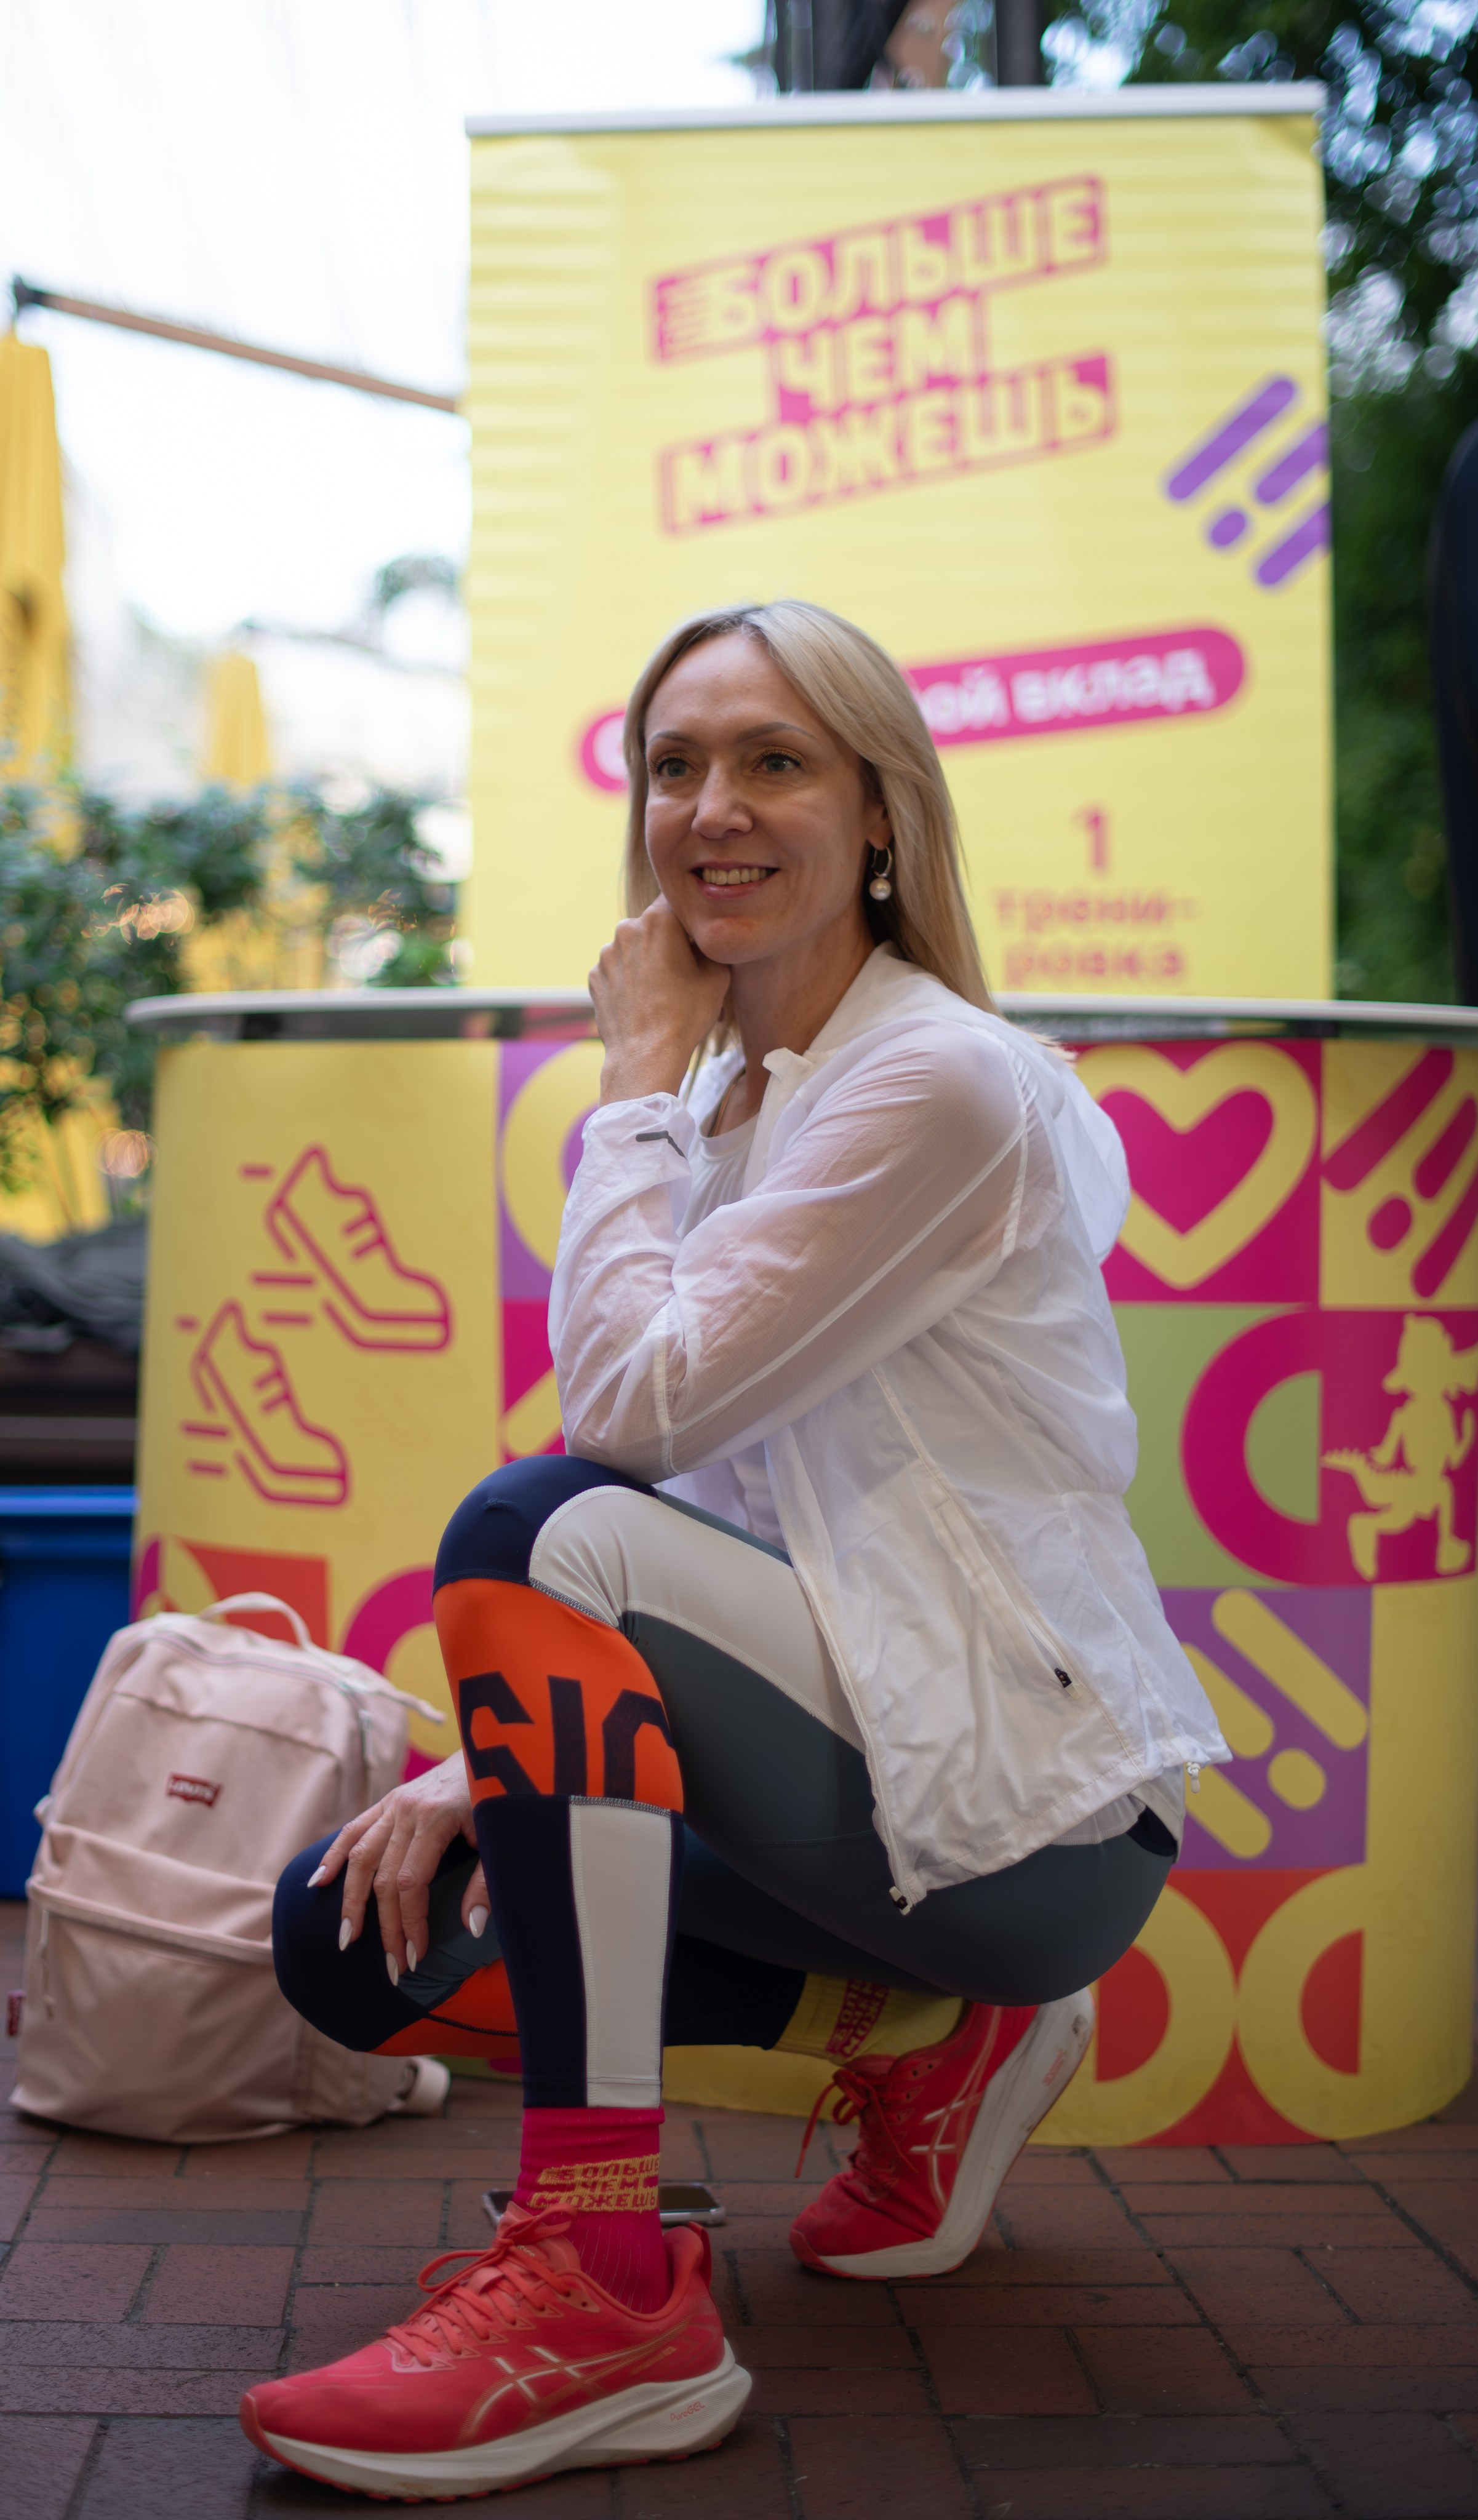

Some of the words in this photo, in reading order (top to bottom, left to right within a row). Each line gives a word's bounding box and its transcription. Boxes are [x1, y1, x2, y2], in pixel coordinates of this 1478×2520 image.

[677, 185, 1100, 337] БОЛЬШЕ
[779, 299, 977, 406] ЧЕМ
[672, 365, 1108, 522] МОЖЕШЬ
[1012, 648, 1215, 723] вклад
[1073, 802, 1111, 872] 1
[1005, 944, 1185, 989] ровка
[669, 2401, 706, 2422] PureGEL
